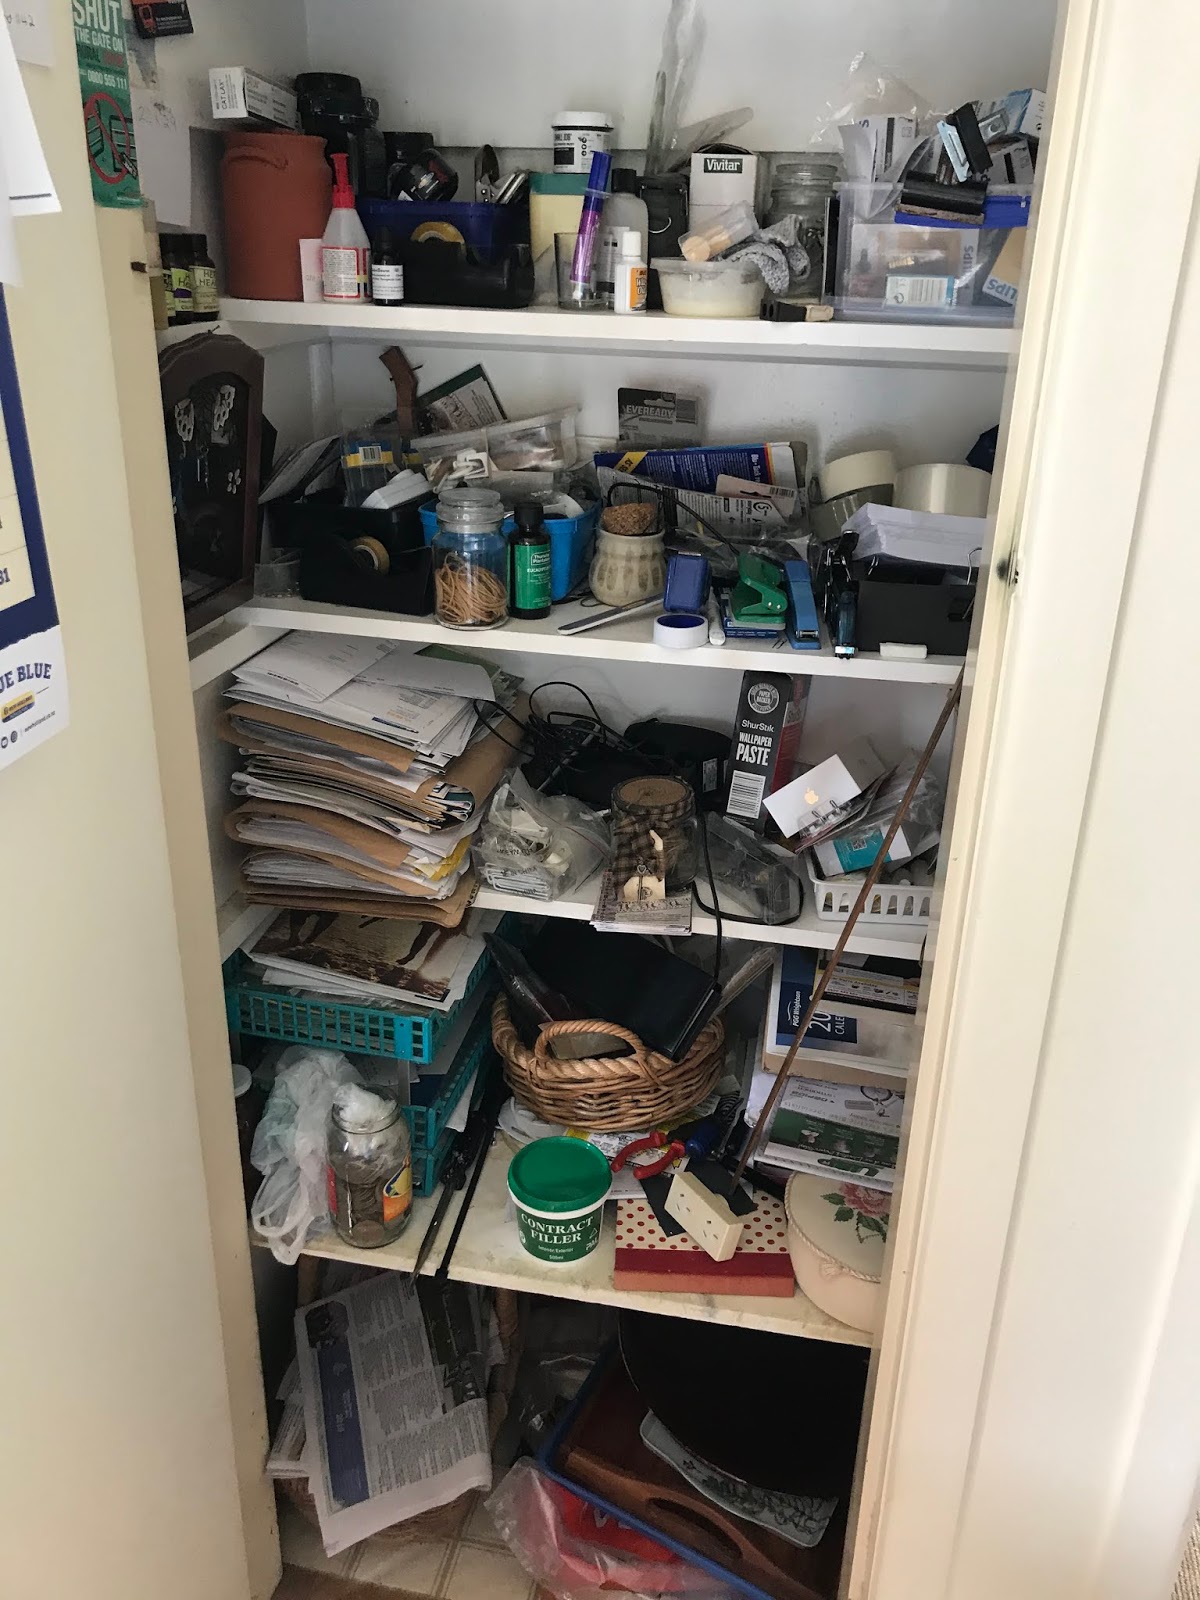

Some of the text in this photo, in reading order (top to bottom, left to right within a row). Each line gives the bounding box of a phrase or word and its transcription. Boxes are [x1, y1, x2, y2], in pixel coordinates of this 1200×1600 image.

[72, 0, 120, 36] SHUT
[75, 26, 124, 53] THE GATE ON
[220, 95, 228, 110] CAT
[706, 158, 741, 172] Vivitar
[986, 278, 1018, 300] LIPS
[626, 404, 674, 419] EVEREADY
[16, 662, 52, 683] BLUE
[739, 731, 773, 748] WALLPAPER
[735, 742, 771, 766] PASTE
[792, 1015, 800, 1027] PGG
[834, 1014, 845, 1035] CALE
[521, 1213, 594, 1234] CONTRACT
[530, 1228, 582, 1245] FILLER
